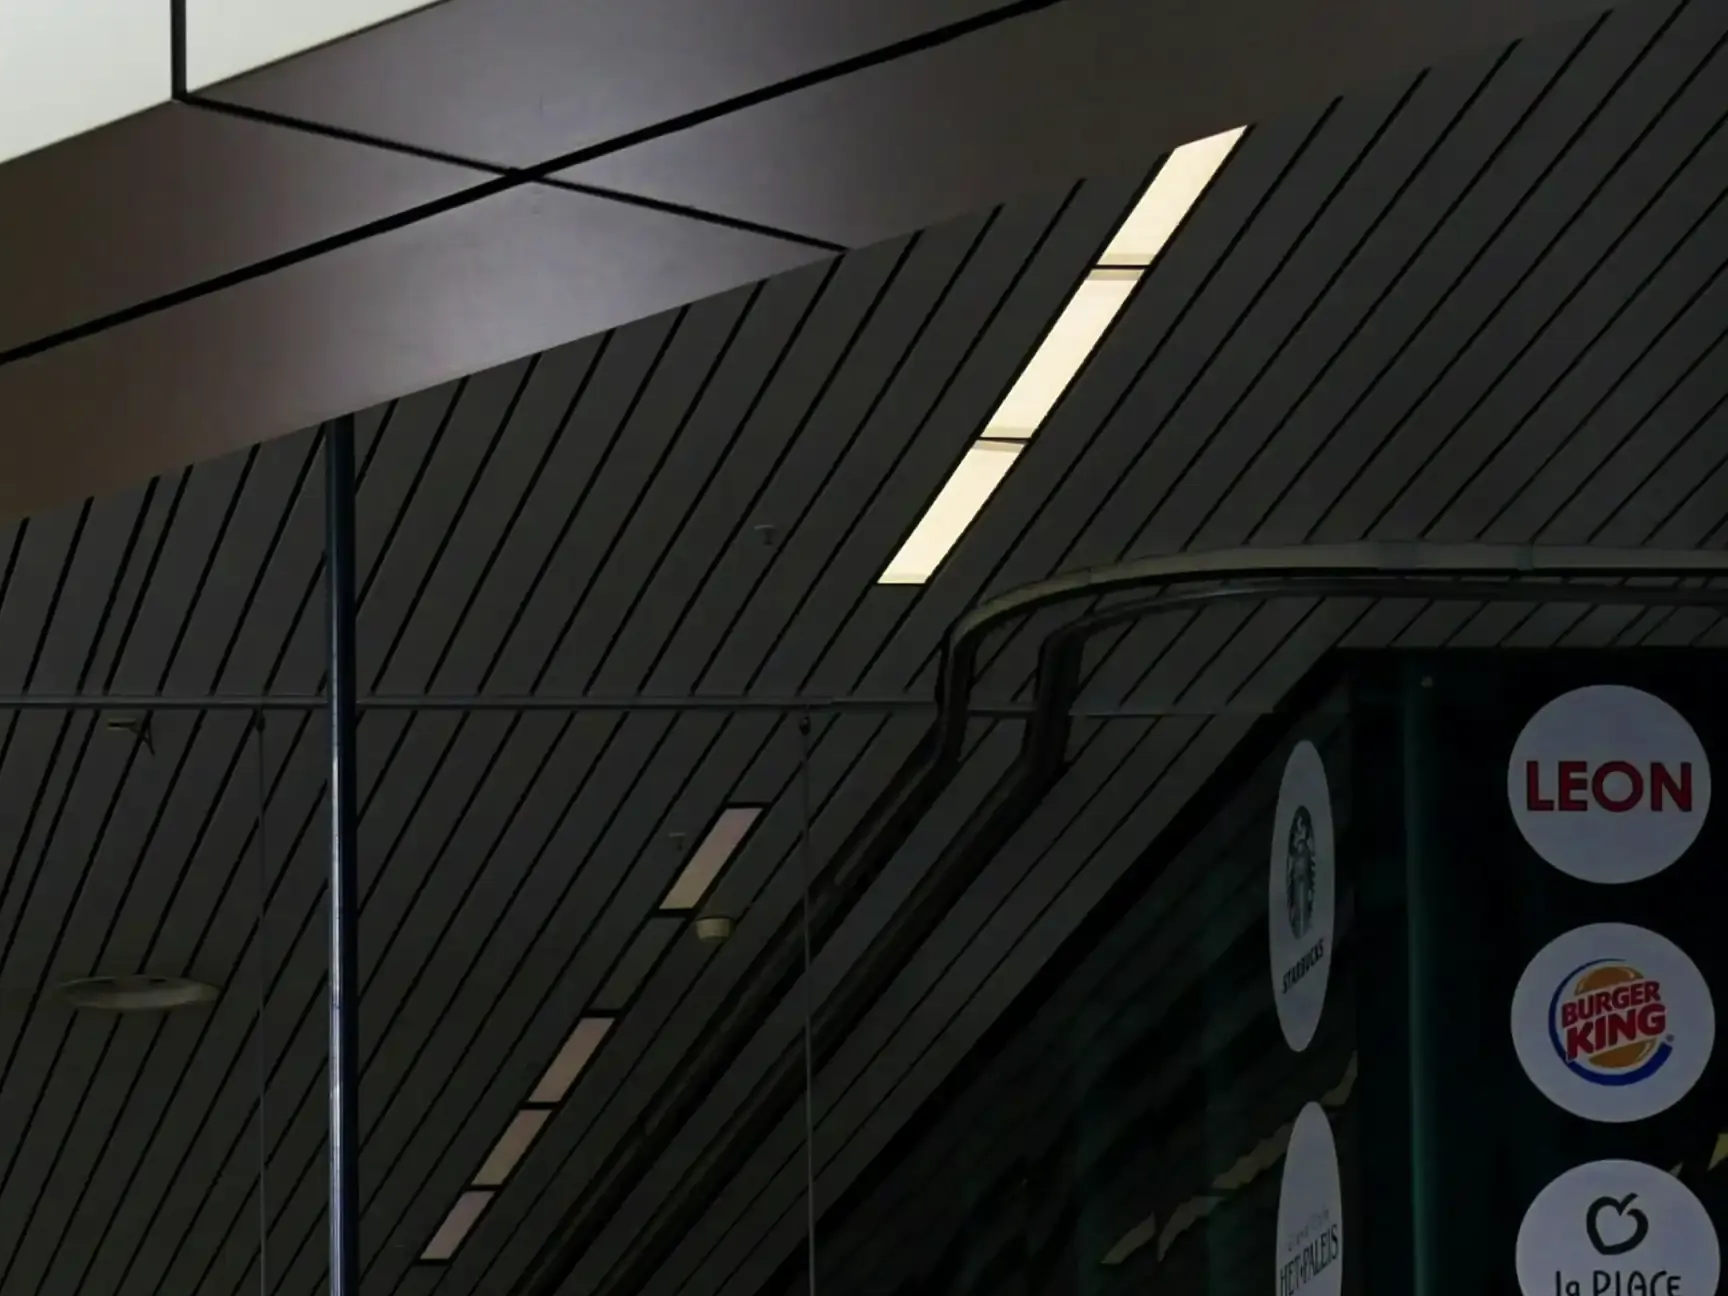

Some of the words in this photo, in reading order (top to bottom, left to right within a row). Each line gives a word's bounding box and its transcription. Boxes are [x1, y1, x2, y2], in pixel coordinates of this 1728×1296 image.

[1526, 761, 1692, 813] LEON
[1561, 981, 1661, 1028] BURGER
[1566, 1003, 1666, 1060] KING
